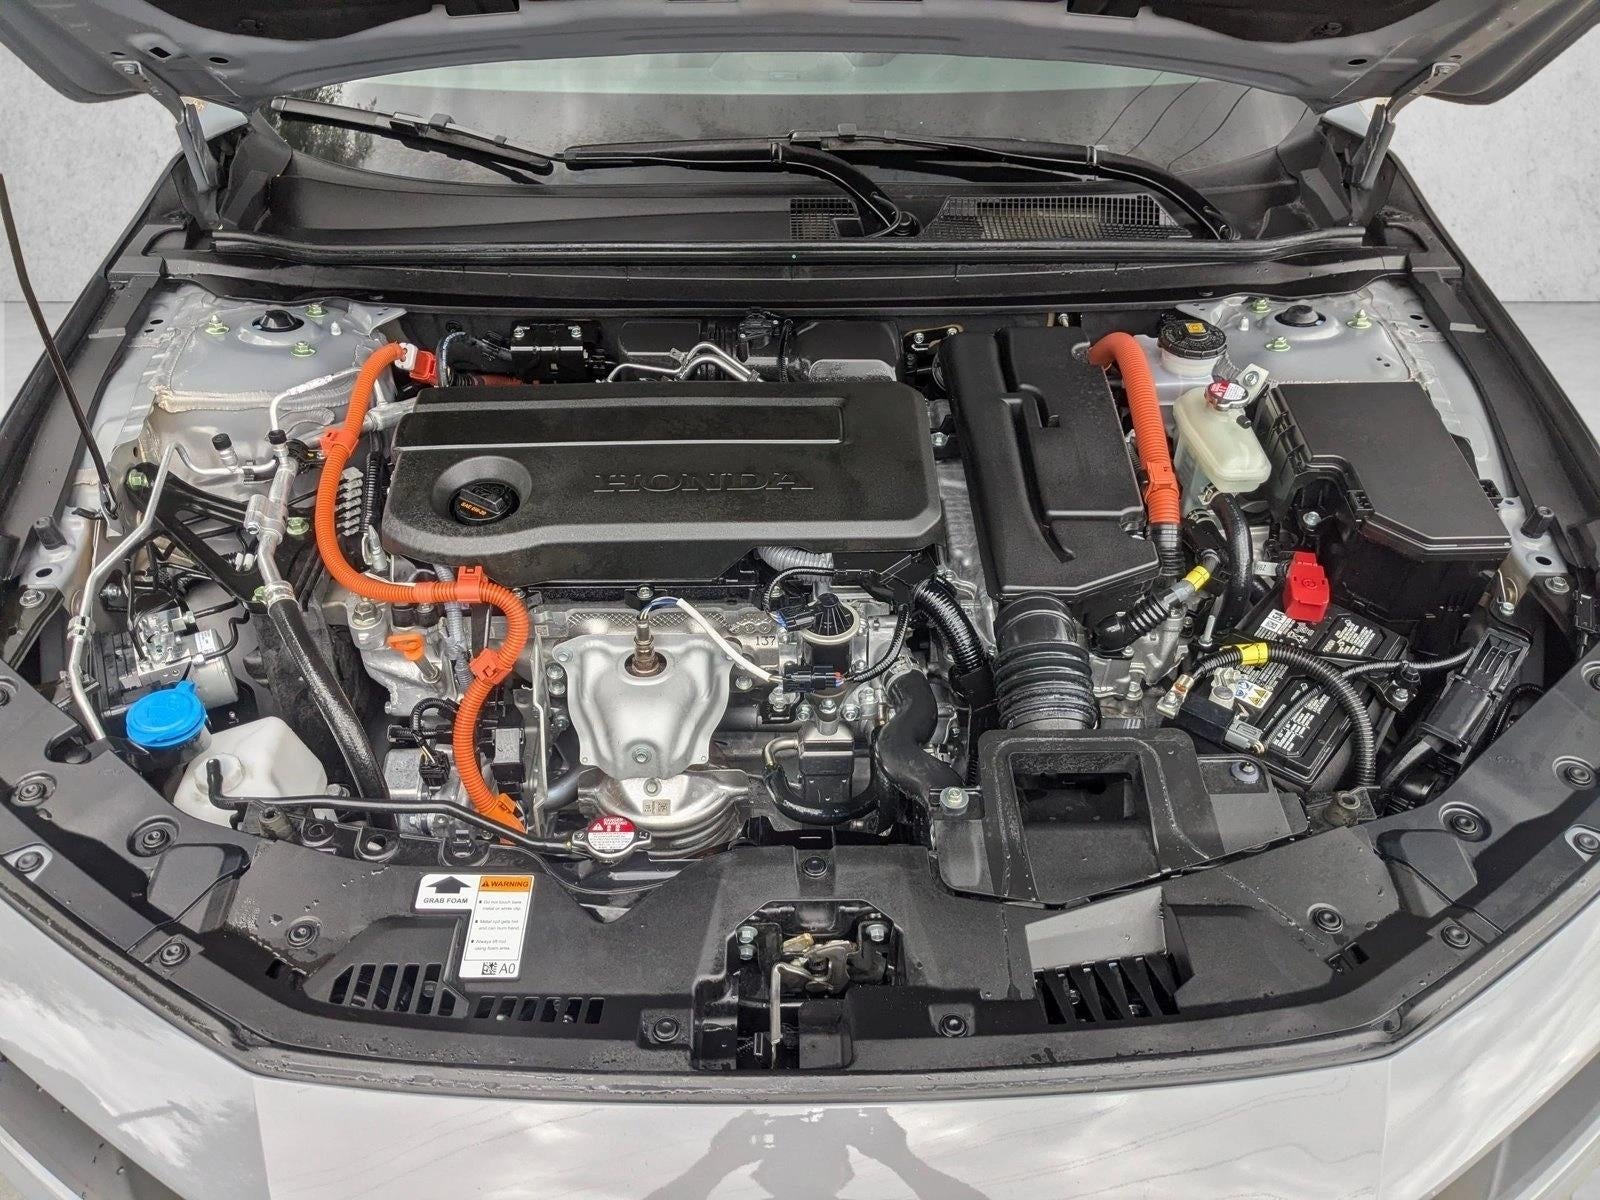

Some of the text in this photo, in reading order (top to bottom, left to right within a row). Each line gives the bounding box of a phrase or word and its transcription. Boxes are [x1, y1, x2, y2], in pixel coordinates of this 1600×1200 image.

[593, 472, 815, 493] HONDA
[460, 501, 472, 510] SAE
[756, 635, 776, 646] 137
[490, 880, 529, 888] WARNING
[498, 962, 516, 975] A0
